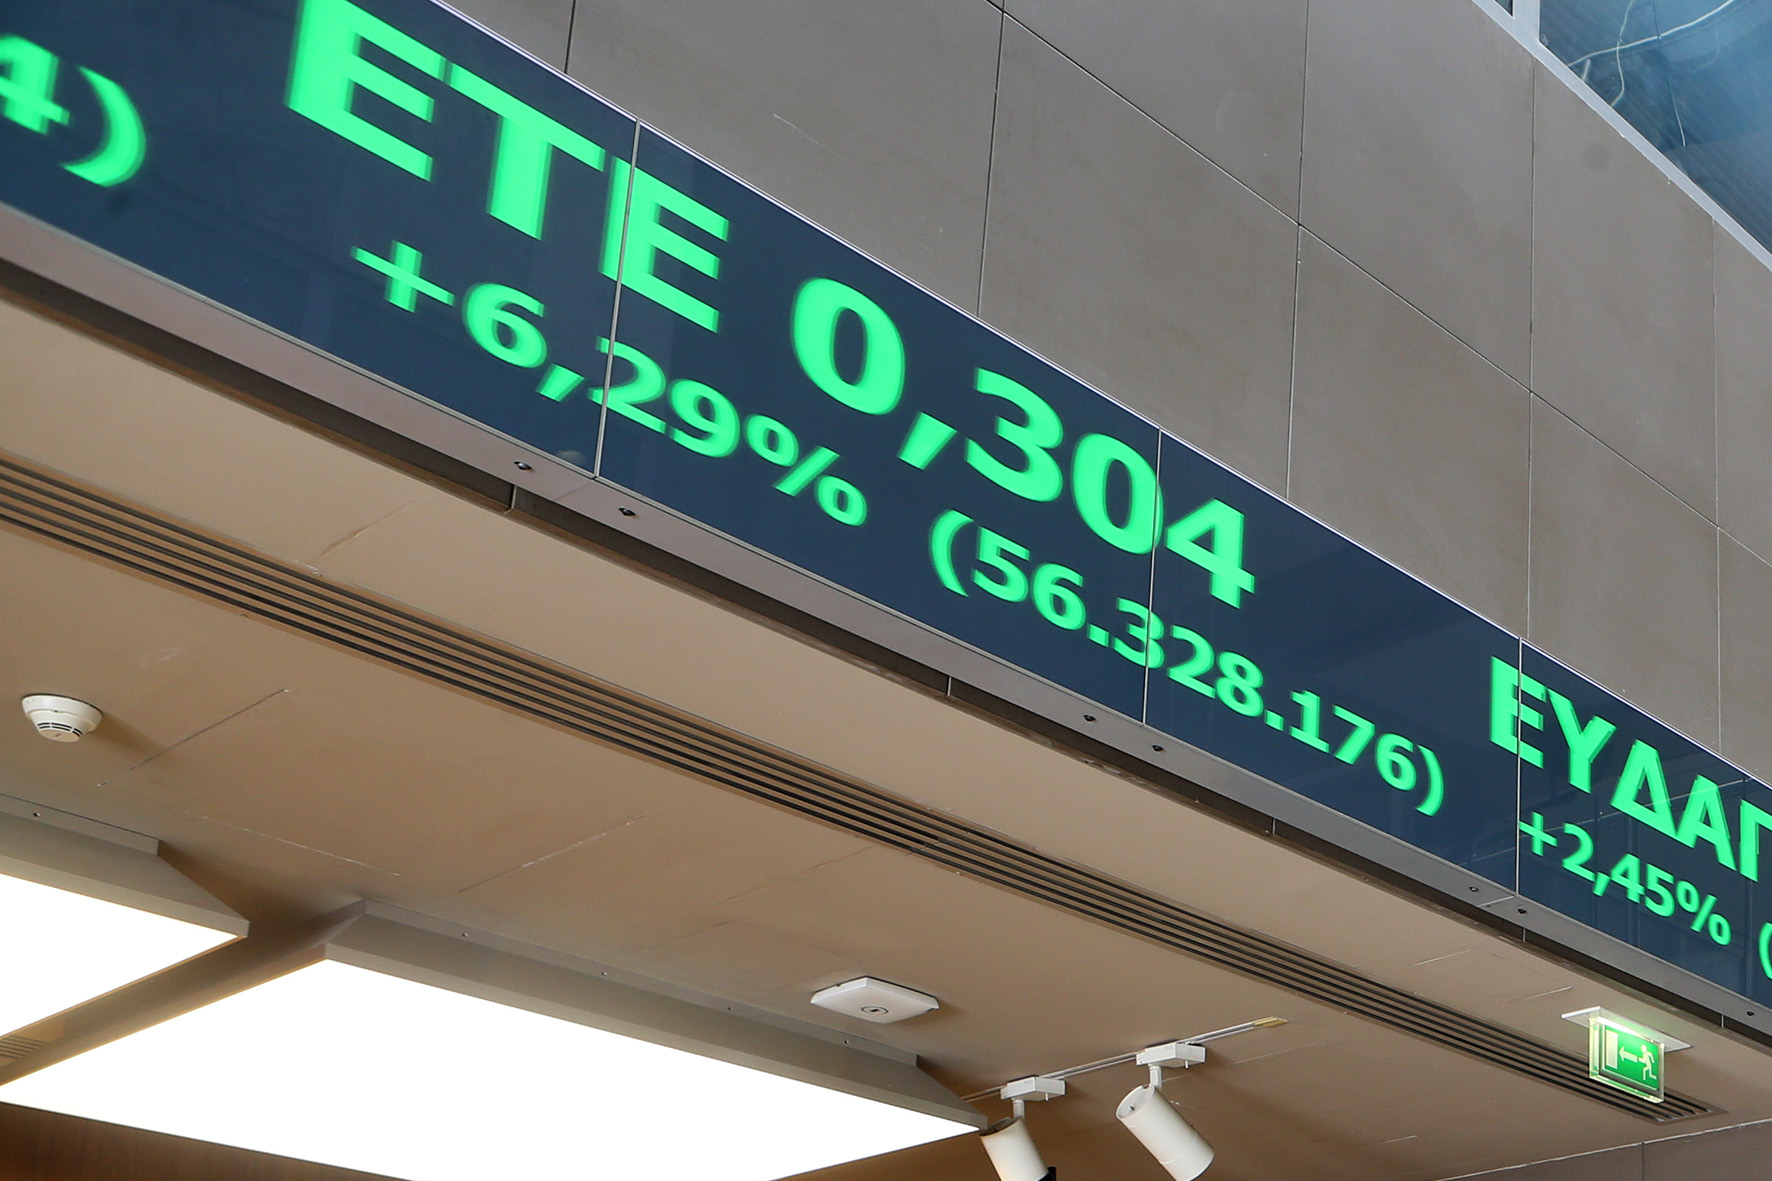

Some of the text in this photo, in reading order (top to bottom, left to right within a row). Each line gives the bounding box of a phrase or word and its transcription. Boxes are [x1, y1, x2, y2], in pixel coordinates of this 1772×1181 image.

[286, 0, 1256, 608] ΕΤΕ 0,304
[354, 242, 1444, 816] +6,29% (56.328.176)
[1519, 813, 1731, 947] +2,45%
